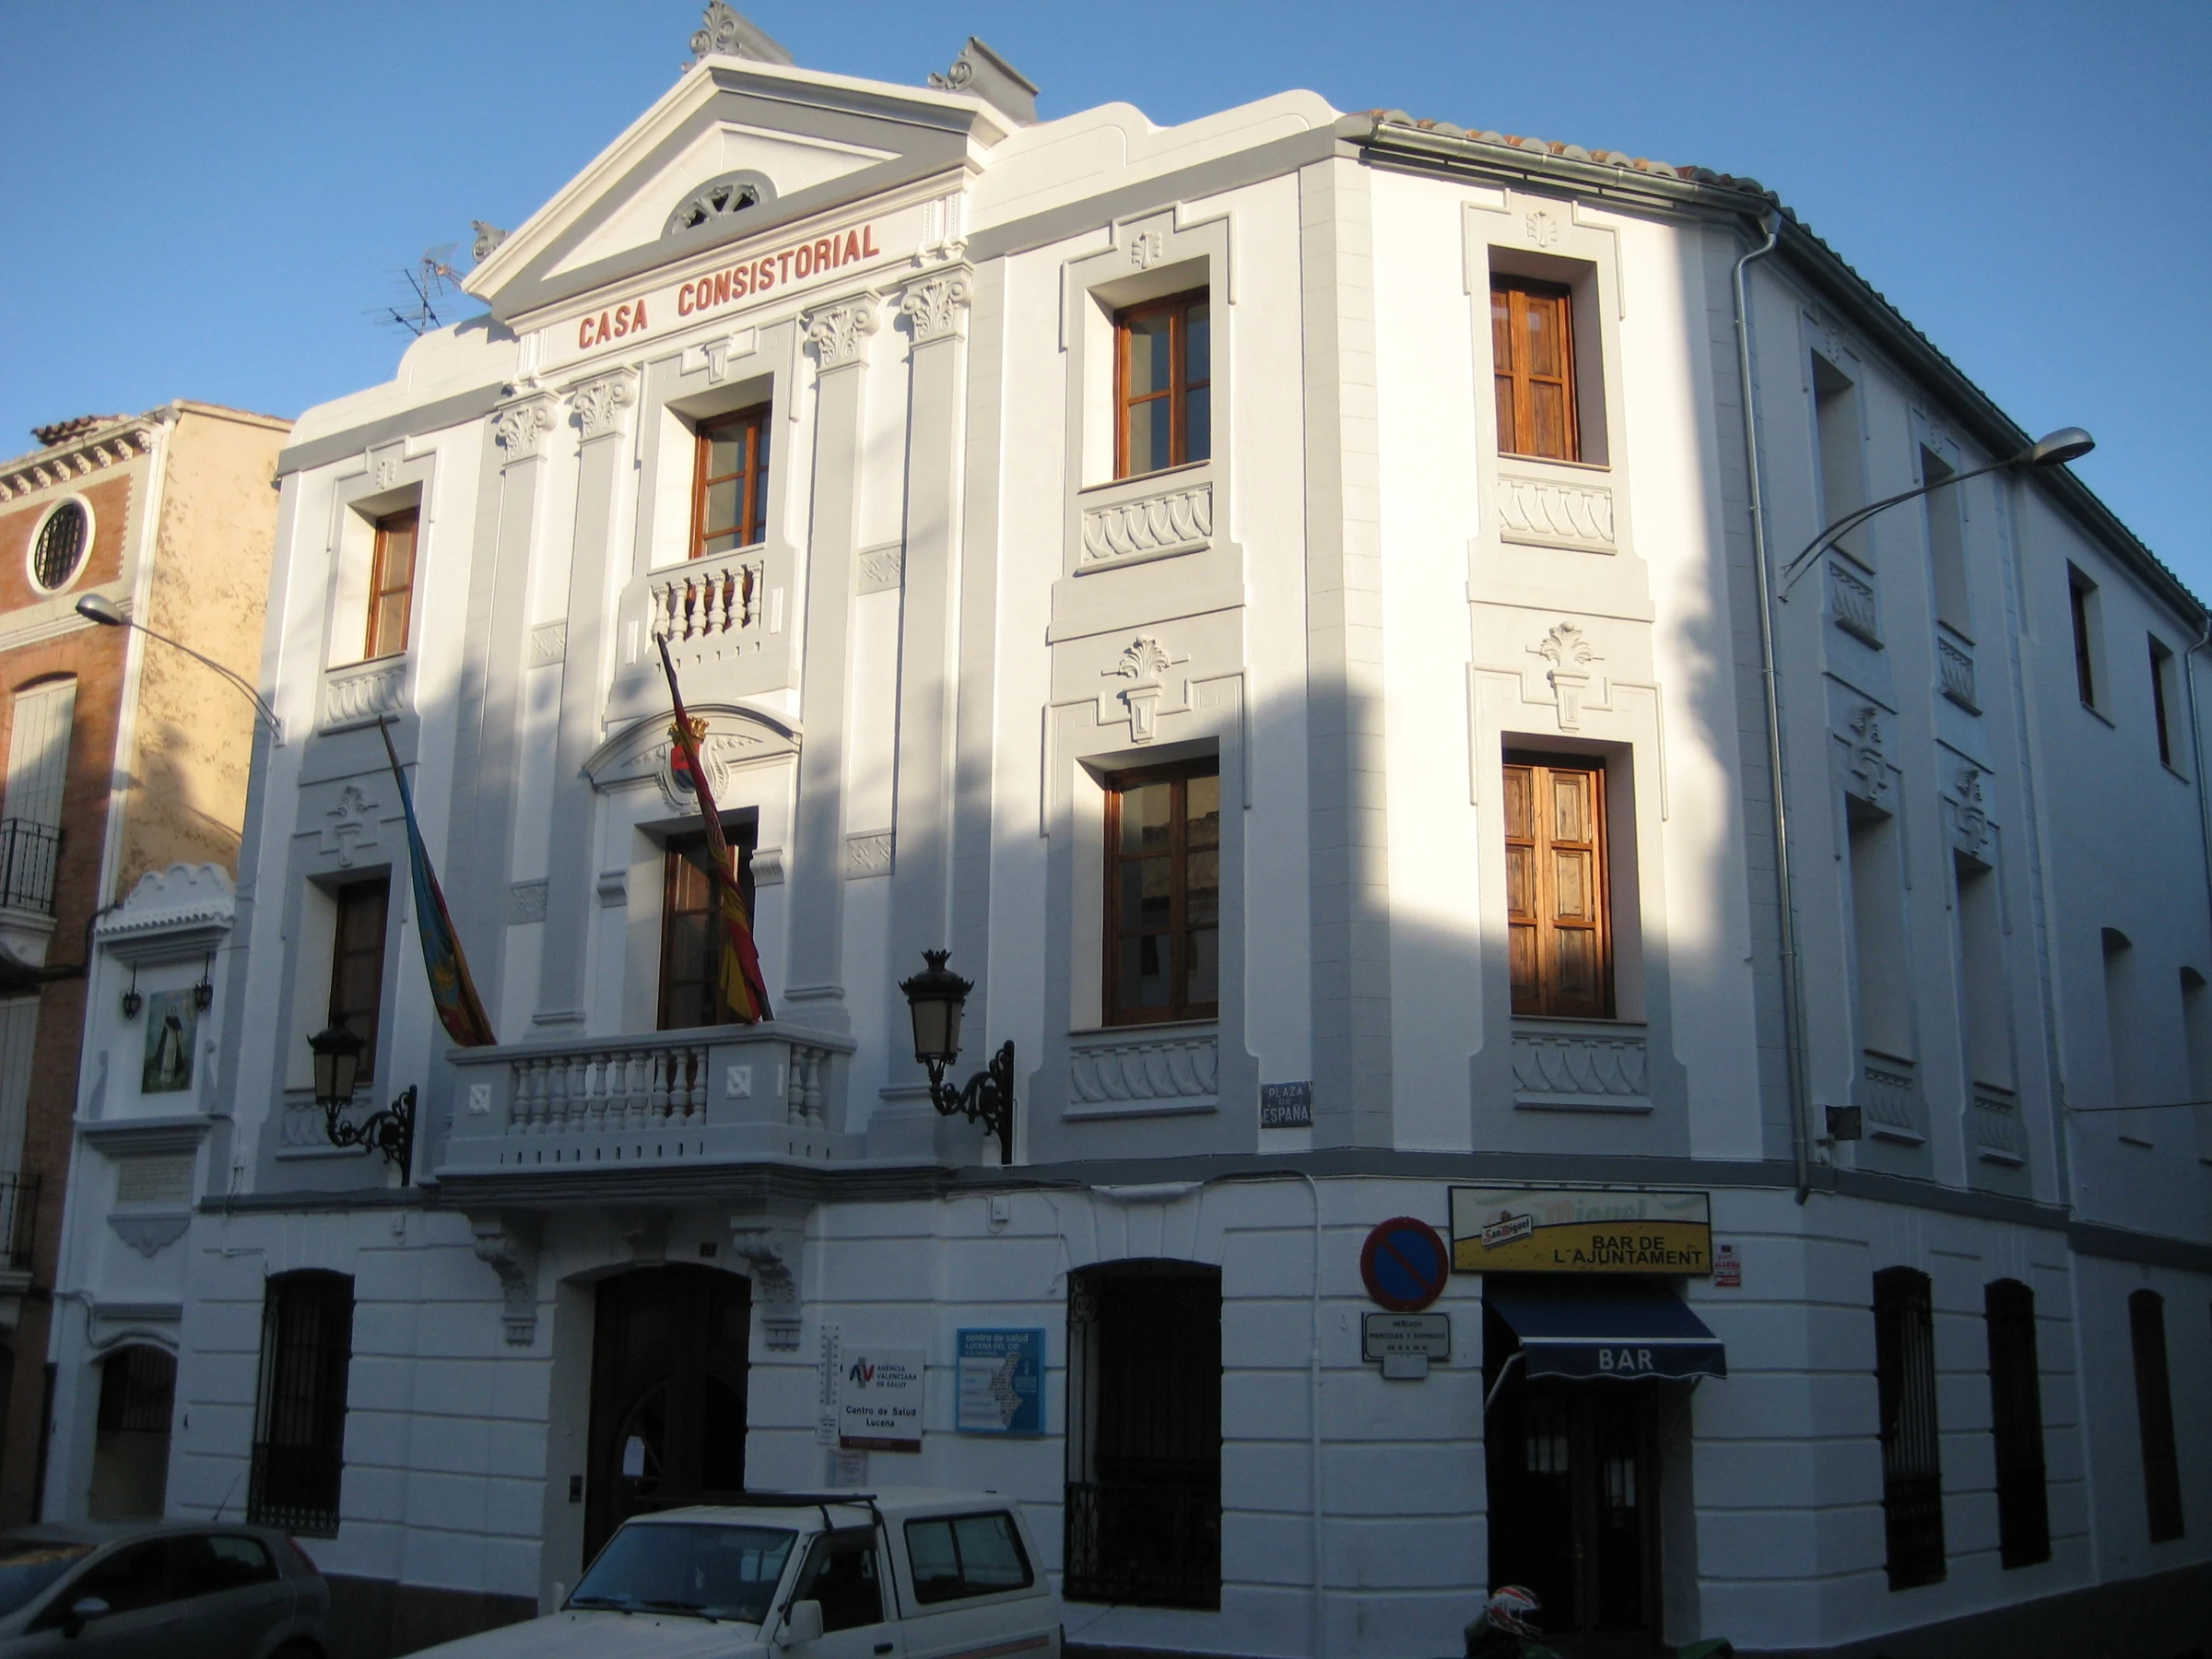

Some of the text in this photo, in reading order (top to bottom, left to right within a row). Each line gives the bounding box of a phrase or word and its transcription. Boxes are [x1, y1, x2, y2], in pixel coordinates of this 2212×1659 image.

[579, 225, 880, 348] CASA CONSISTORIAL
[1268, 1087, 1303, 1098] PLAZA
[1263, 1104, 1309, 1124] ESPAÑA
[1593, 1235, 1665, 1251] BAR DE
[965, 1333, 1029, 1343] centro de salud
[1598, 1348, 1654, 1371] BAR
[877, 1372, 918, 1381] VALENCIANA
[845, 1406, 916, 1417] Centro de Salud
[865, 1418, 895, 1428] Lucena
